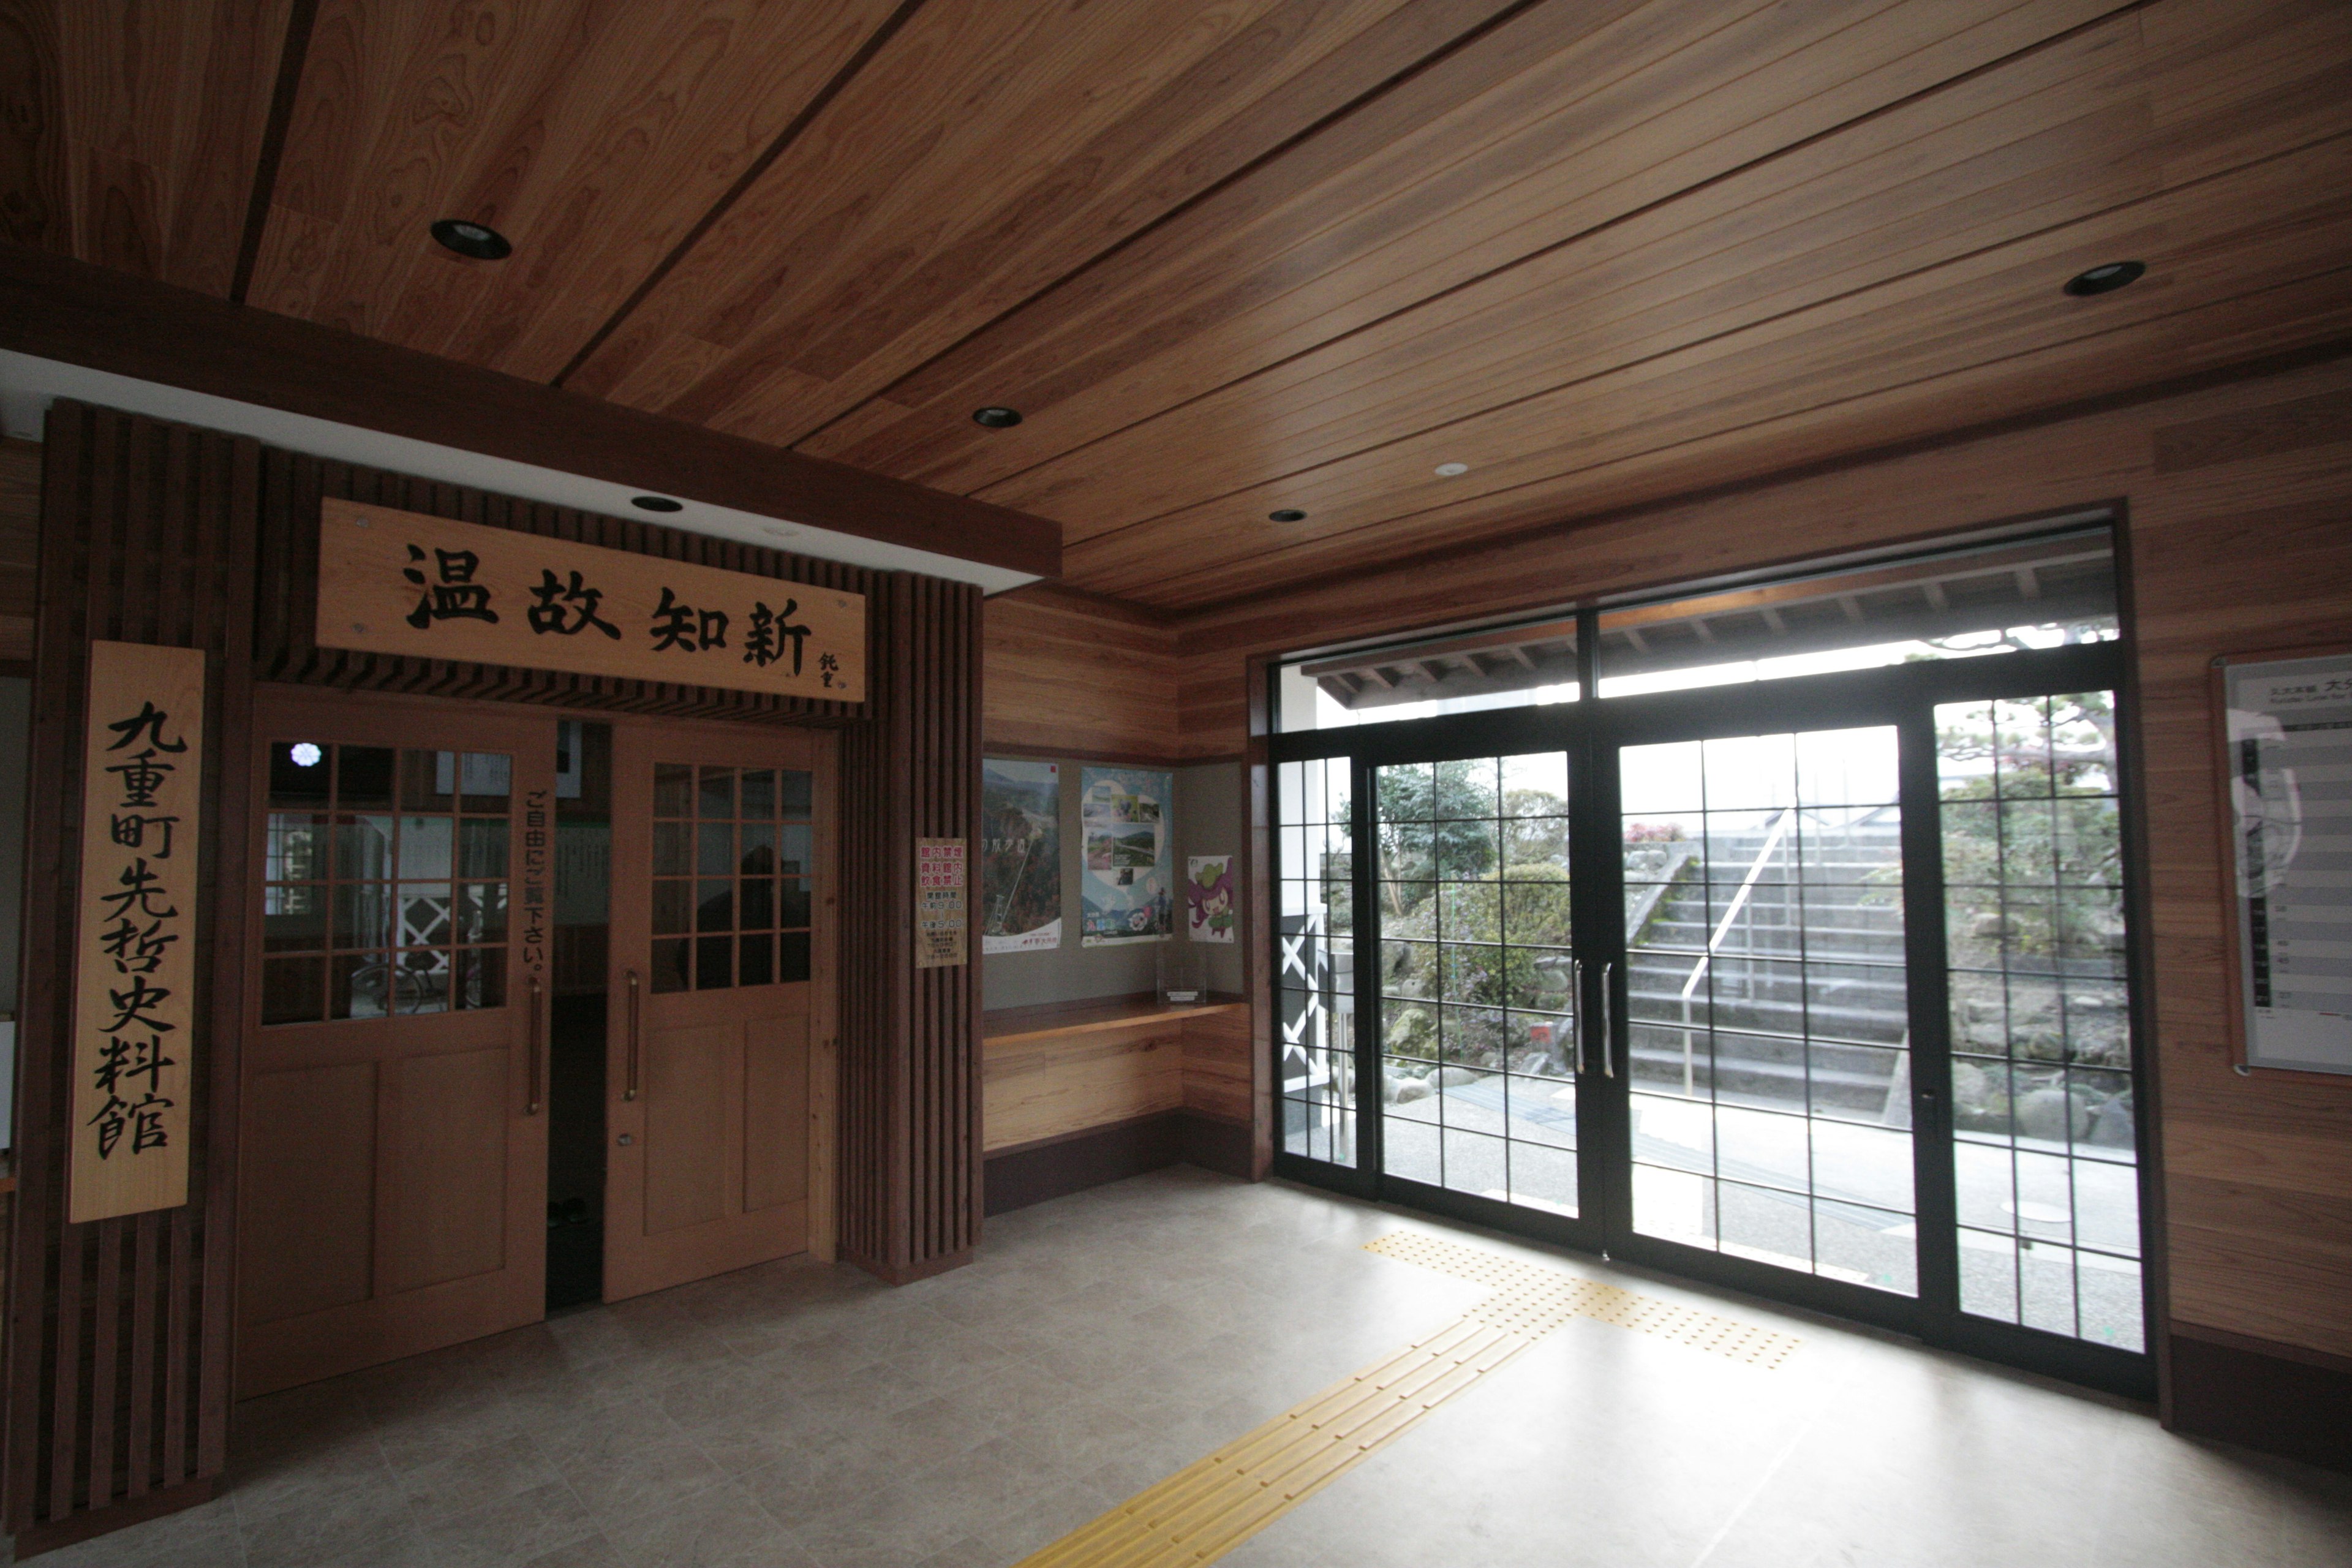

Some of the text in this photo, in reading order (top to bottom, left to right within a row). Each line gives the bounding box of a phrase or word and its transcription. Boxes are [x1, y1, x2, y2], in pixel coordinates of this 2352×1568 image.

[403, 544, 813, 678] 温故知新
[522, 789, 548, 971] ご自由にご覧下さい。
[921, 846, 963, 858] 館内禁煙
[921, 862, 963, 874] 資料館内
[921, 875, 963, 886] 飲食禁止
[87, 701, 187, 1160] 九重町先哲史料館
